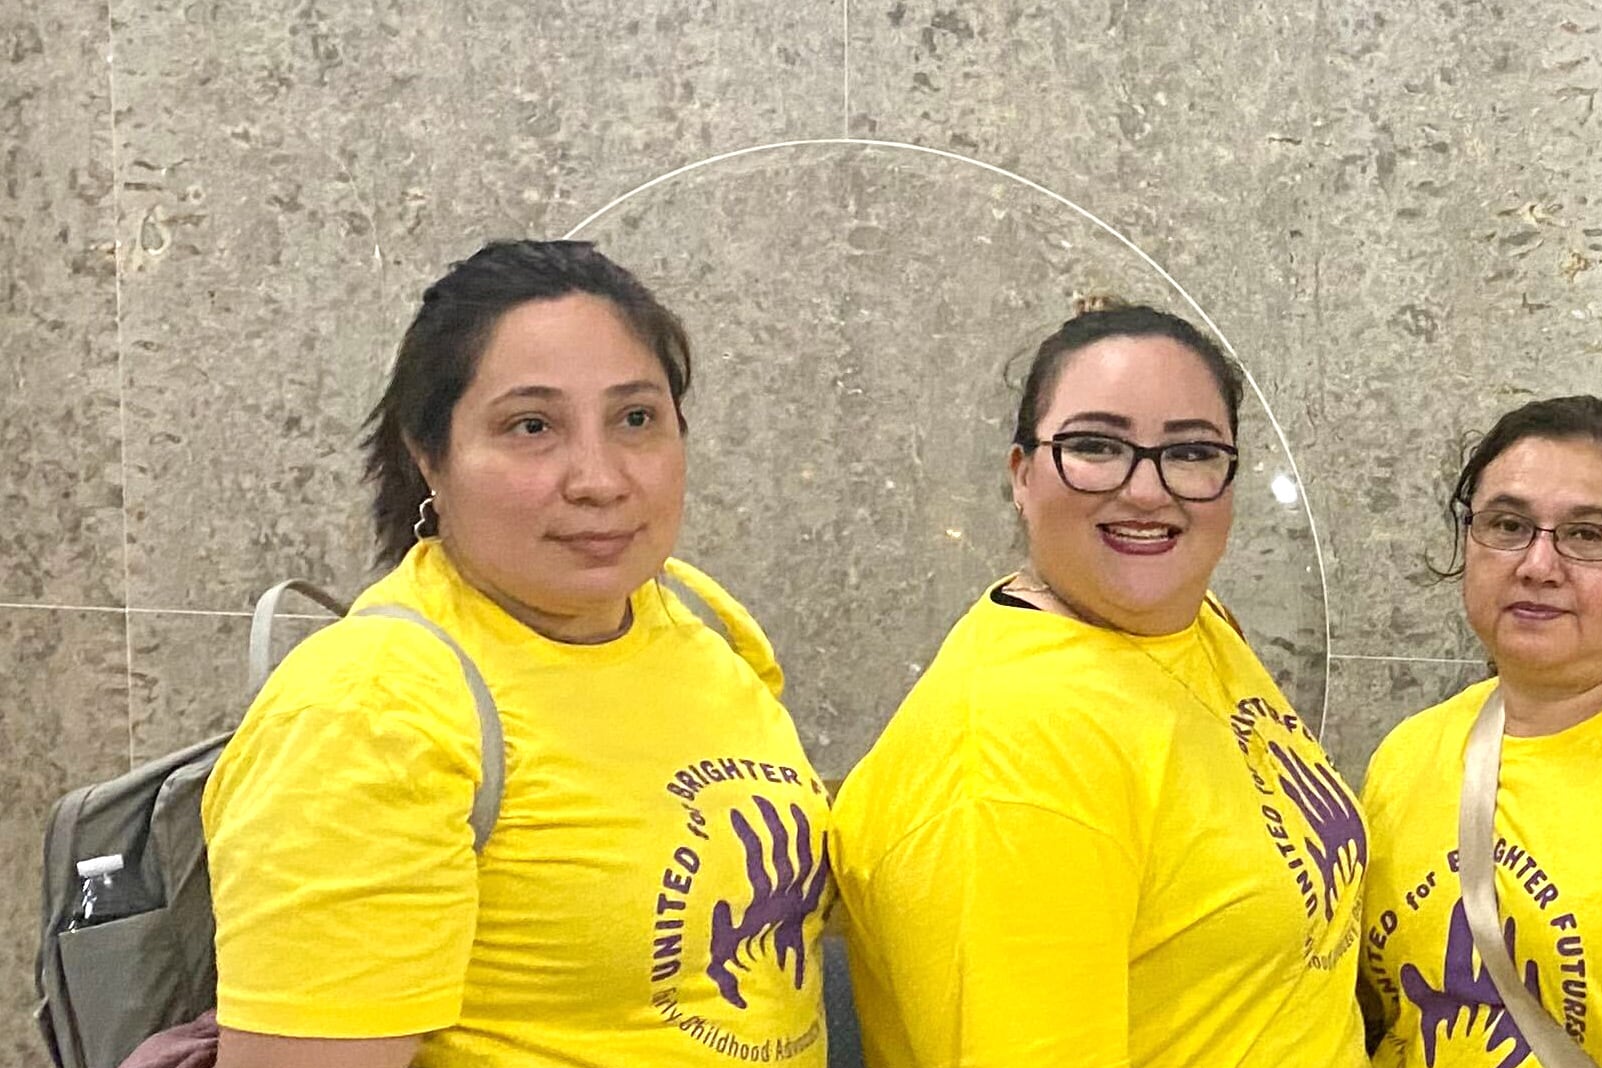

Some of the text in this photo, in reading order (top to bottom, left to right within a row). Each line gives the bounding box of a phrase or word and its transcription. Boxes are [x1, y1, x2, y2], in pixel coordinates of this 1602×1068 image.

[650, 757, 803, 983] UNITED for BRIGHTER
[1261, 804, 1318, 919] UNITED
[1366, 910, 1399, 1003] NITED
[1406, 871, 1436, 910] for
[1447, 837, 1559, 911] BGHTER
